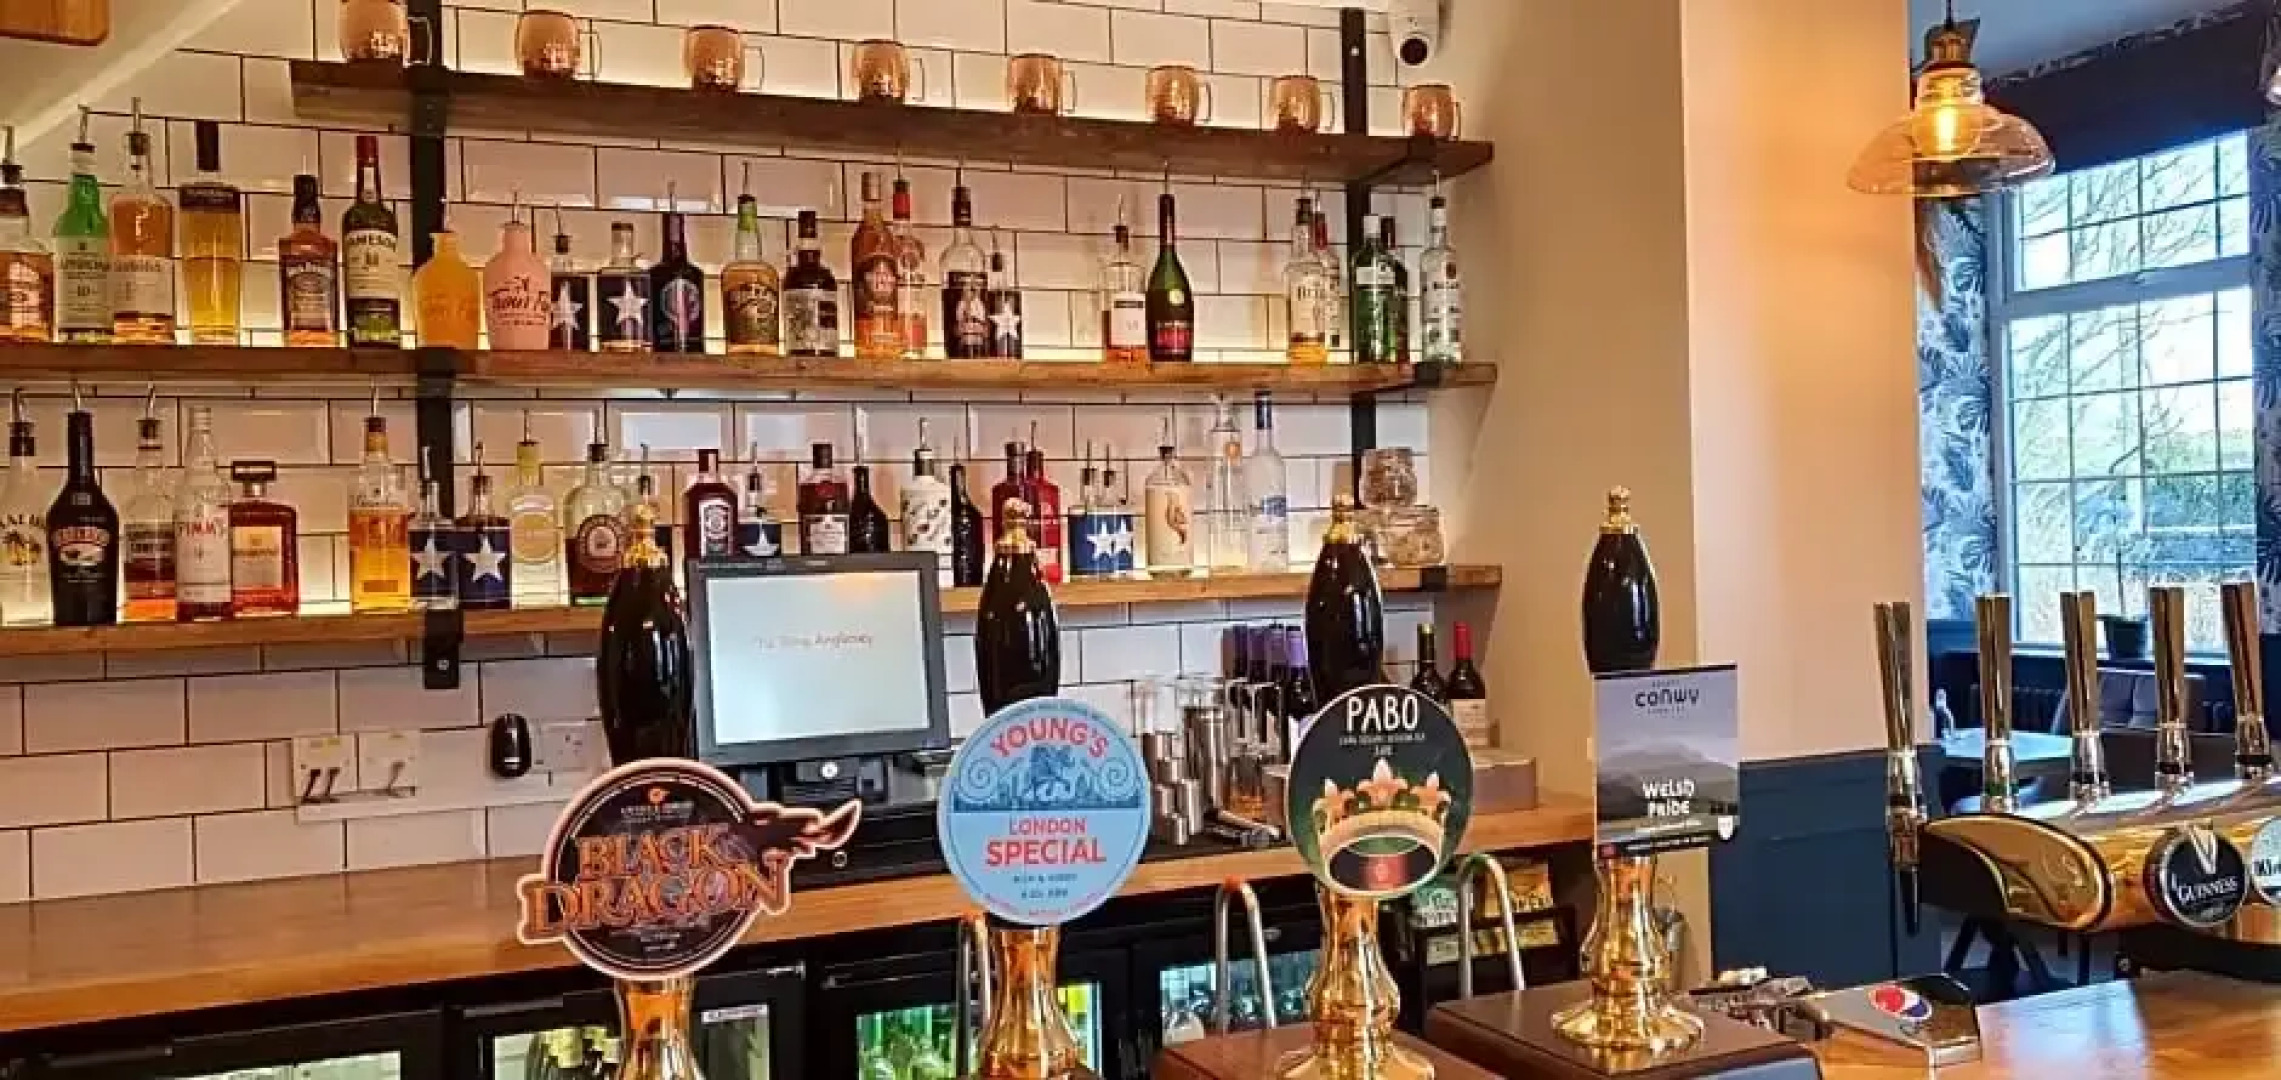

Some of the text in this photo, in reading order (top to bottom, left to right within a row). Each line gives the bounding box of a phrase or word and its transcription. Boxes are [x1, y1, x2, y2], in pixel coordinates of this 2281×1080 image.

[1346, 694, 1419, 734] PABO
[988, 716, 1111, 758] YOUNG'S
[1008, 816, 1087, 836] LONDON
[577, 824, 747, 880] BLACK
[986, 836, 1107, 867] SPECIAL
[526, 848, 788, 932] DRAGON
[2178, 875, 2238, 905] GUINNESS
